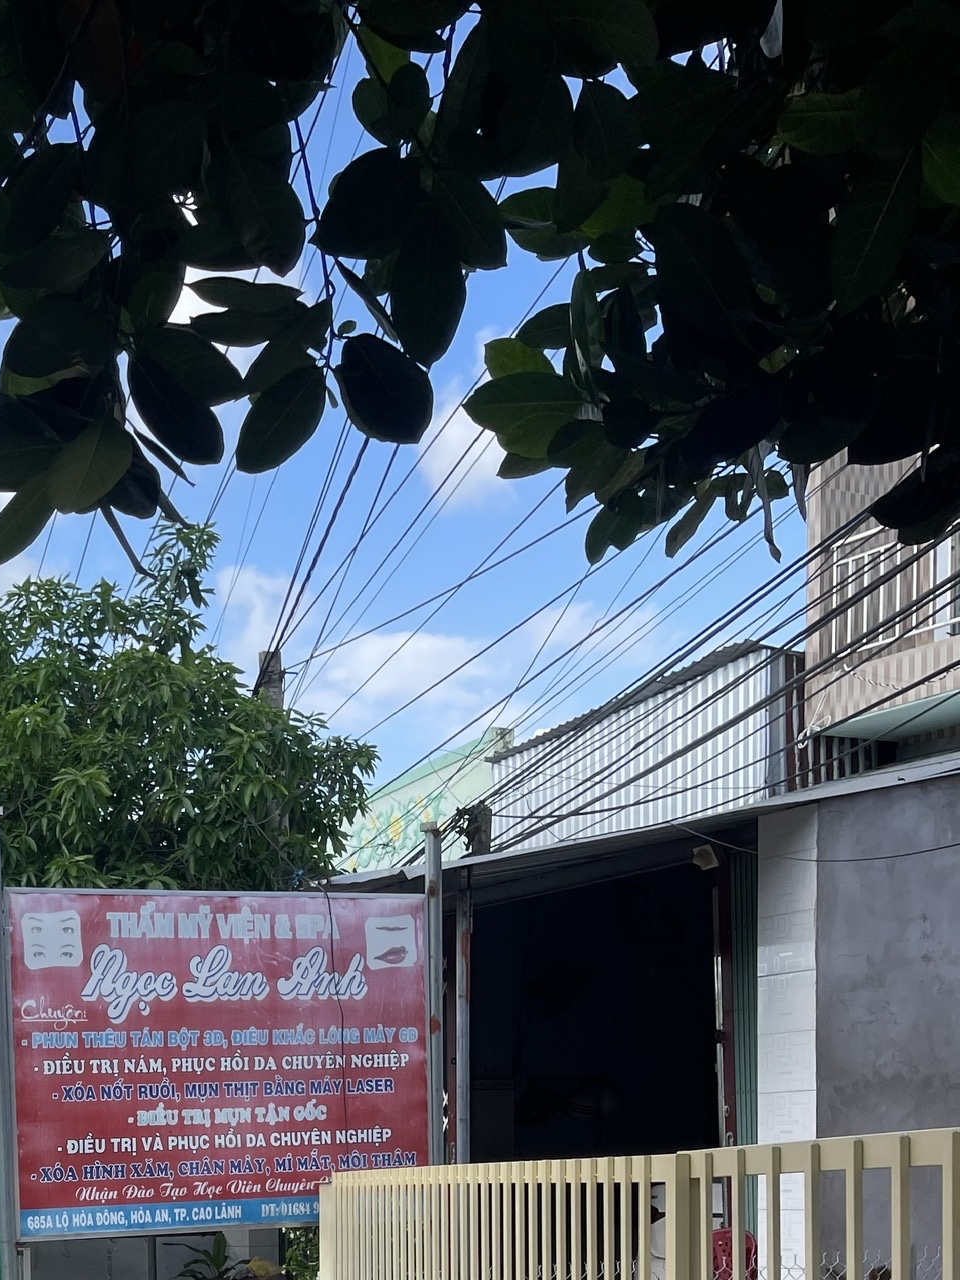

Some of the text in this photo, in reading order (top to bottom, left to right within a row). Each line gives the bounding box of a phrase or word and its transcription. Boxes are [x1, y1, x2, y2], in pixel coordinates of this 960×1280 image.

[216, 905, 270, 944] VIỆN
[274, 914, 293, 938] &
[80, 943, 368, 1024] Ngọc Lan Anh
[31, 1023, 418, 1051] PHUN THÊU TÁN BỘT 3D, ĐIÊU KHẮC LÔNG MÀY 6D
[43, 1050, 410, 1077] ĐIỀU TRỊ NÁM, PHỤC HỒI DA CHUYÊN NGHIỆP
[62, 1081, 96, 1102] XÓA
[100, 1078, 134, 1100] NỐT
[185, 1082, 219, 1102] MỤN
[223, 1082, 259, 1101] THỊT
[263, 1075, 305, 1097] BẰNG
[310, 1075, 343, 1095] MÁY
[346, 1078, 395, 1094] LASER
[66, 1126, 392, 1156] ĐIỀU TRỊ VÀ PHỤC HỒI DA CHUYÊN NGHIỆP
[39, 1162, 79, 1183] XÓA
[81, 1161, 126, 1181] HÌNH
[177, 1156, 225, 1177] CHÂN
[274, 1152, 294, 1173] MÍ
[338, 1150, 368, 1170] MÔI
[75, 1186, 119, 1204] Nhận
[122, 1184, 155, 1200] Đào
[159, 1182, 188, 1200] Tạo
[192, 1181, 223, 1199] Học
[226, 1179, 262, 1194] Viên
[265, 1177, 316, 1193] Chuyên
[26, 1215, 53, 1230] 685A
[55, 1211, 69, 1231] LỘ
[72, 1210, 94, 1228] HÒA
[155, 1208, 172, 1224] AN,
[173, 1207, 190, 1222] TP.
[191, 1206, 212, 1221] CAO
[214, 1202, 242, 1220] LÃNH
